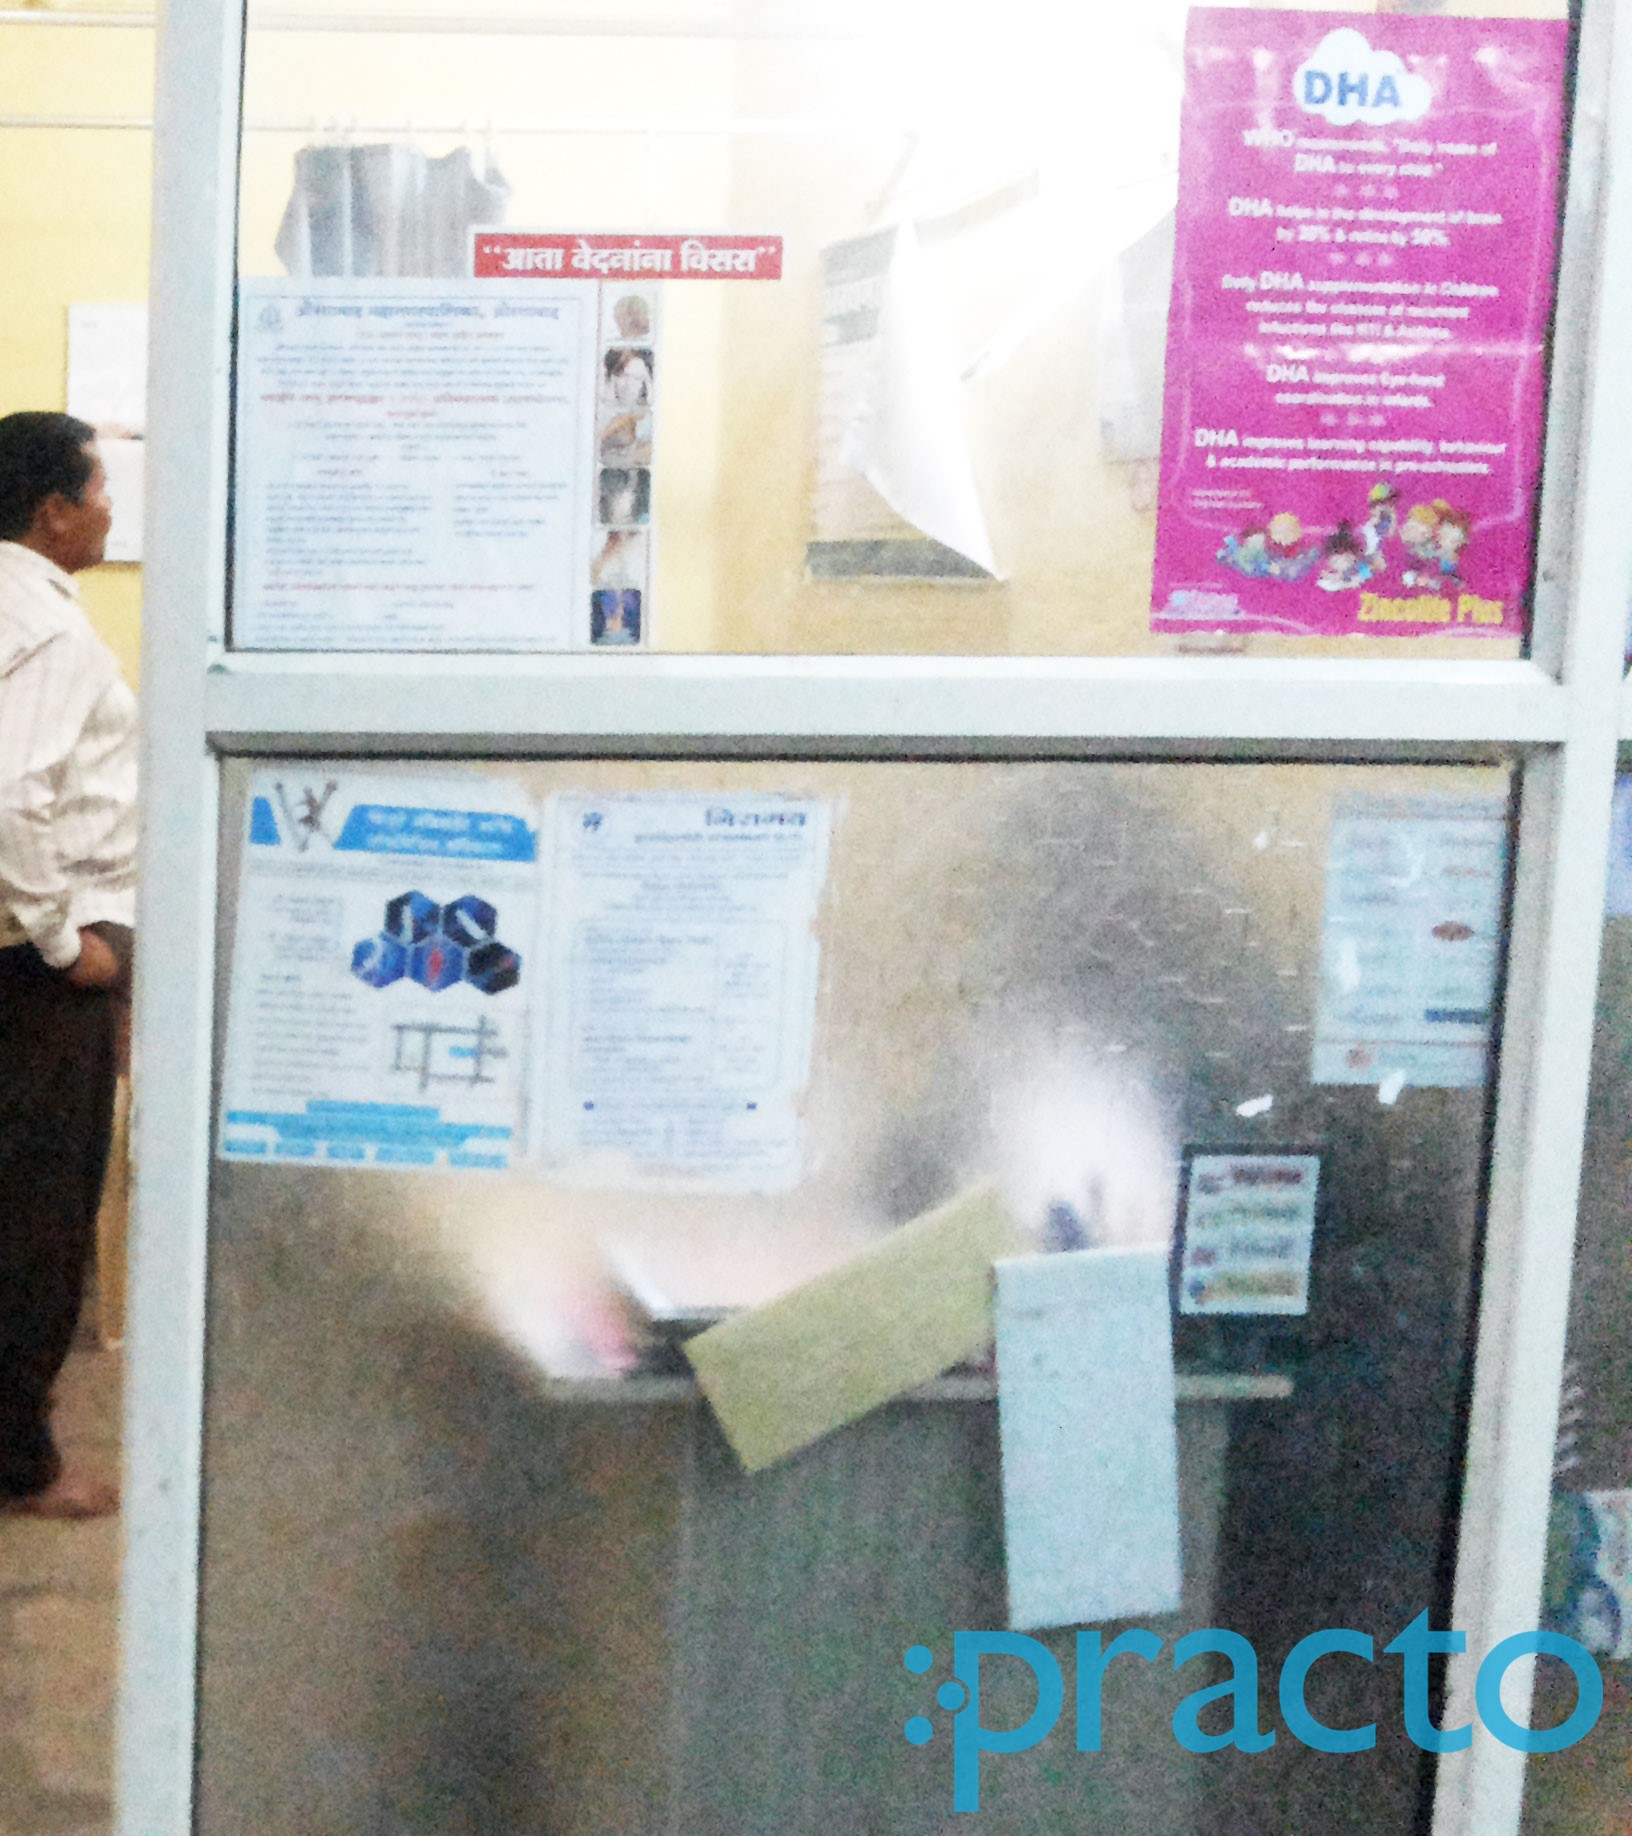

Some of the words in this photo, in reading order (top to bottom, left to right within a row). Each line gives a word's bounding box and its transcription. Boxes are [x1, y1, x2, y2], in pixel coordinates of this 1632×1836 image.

[1304, 69, 1402, 108] DHA
[1295, 154, 1336, 173] DHA
[1228, 196, 1273, 217] DHA
[1259, 271, 1304, 290] DHA
[1266, 364, 1309, 384] DHA
[1194, 428, 1239, 448] DHA
